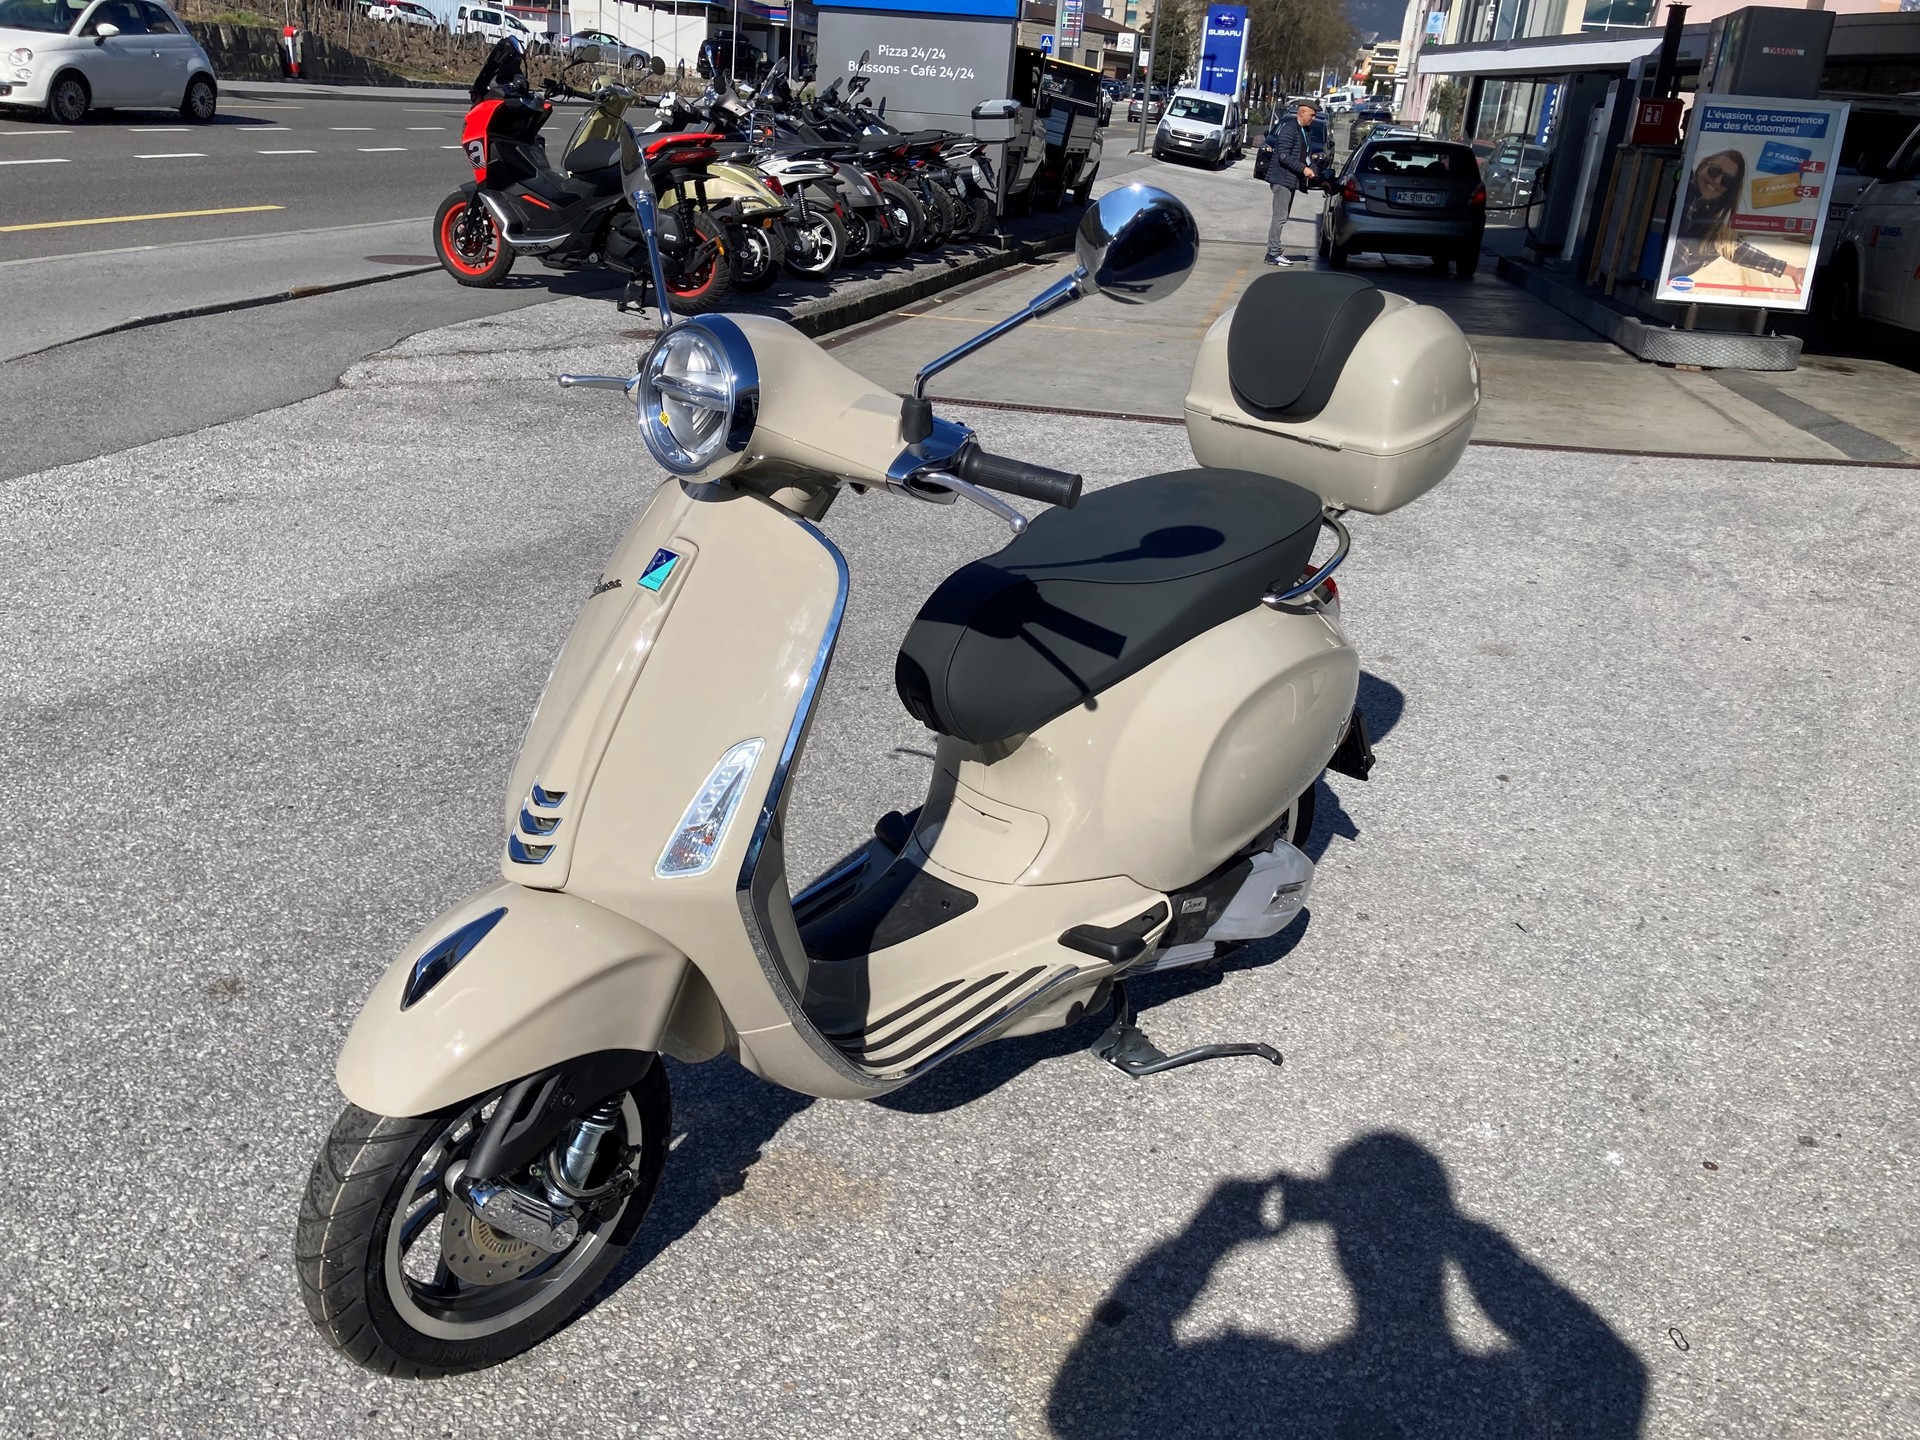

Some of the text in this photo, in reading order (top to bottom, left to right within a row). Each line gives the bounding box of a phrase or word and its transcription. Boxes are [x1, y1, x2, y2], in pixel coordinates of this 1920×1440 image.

[1208, 29, 1242, 37] SUBARU
[878, 44, 946, 60] Pizza 24/24
[848, 60, 900, 76] Boissons
[910, 64, 937, 78] Café
[939, 66, 975, 80] 24/24
[1707, 109, 1825, 125] L'évasion, ça commence
[1704, 121, 1800, 134] par des économies!
[1774, 152, 1805, 164] TAMOIL
[1764, 182, 1798, 192] TAMOIL
[1397, 191, 1406, 201] AZ
[1409, 192, 1423, 201] 919
